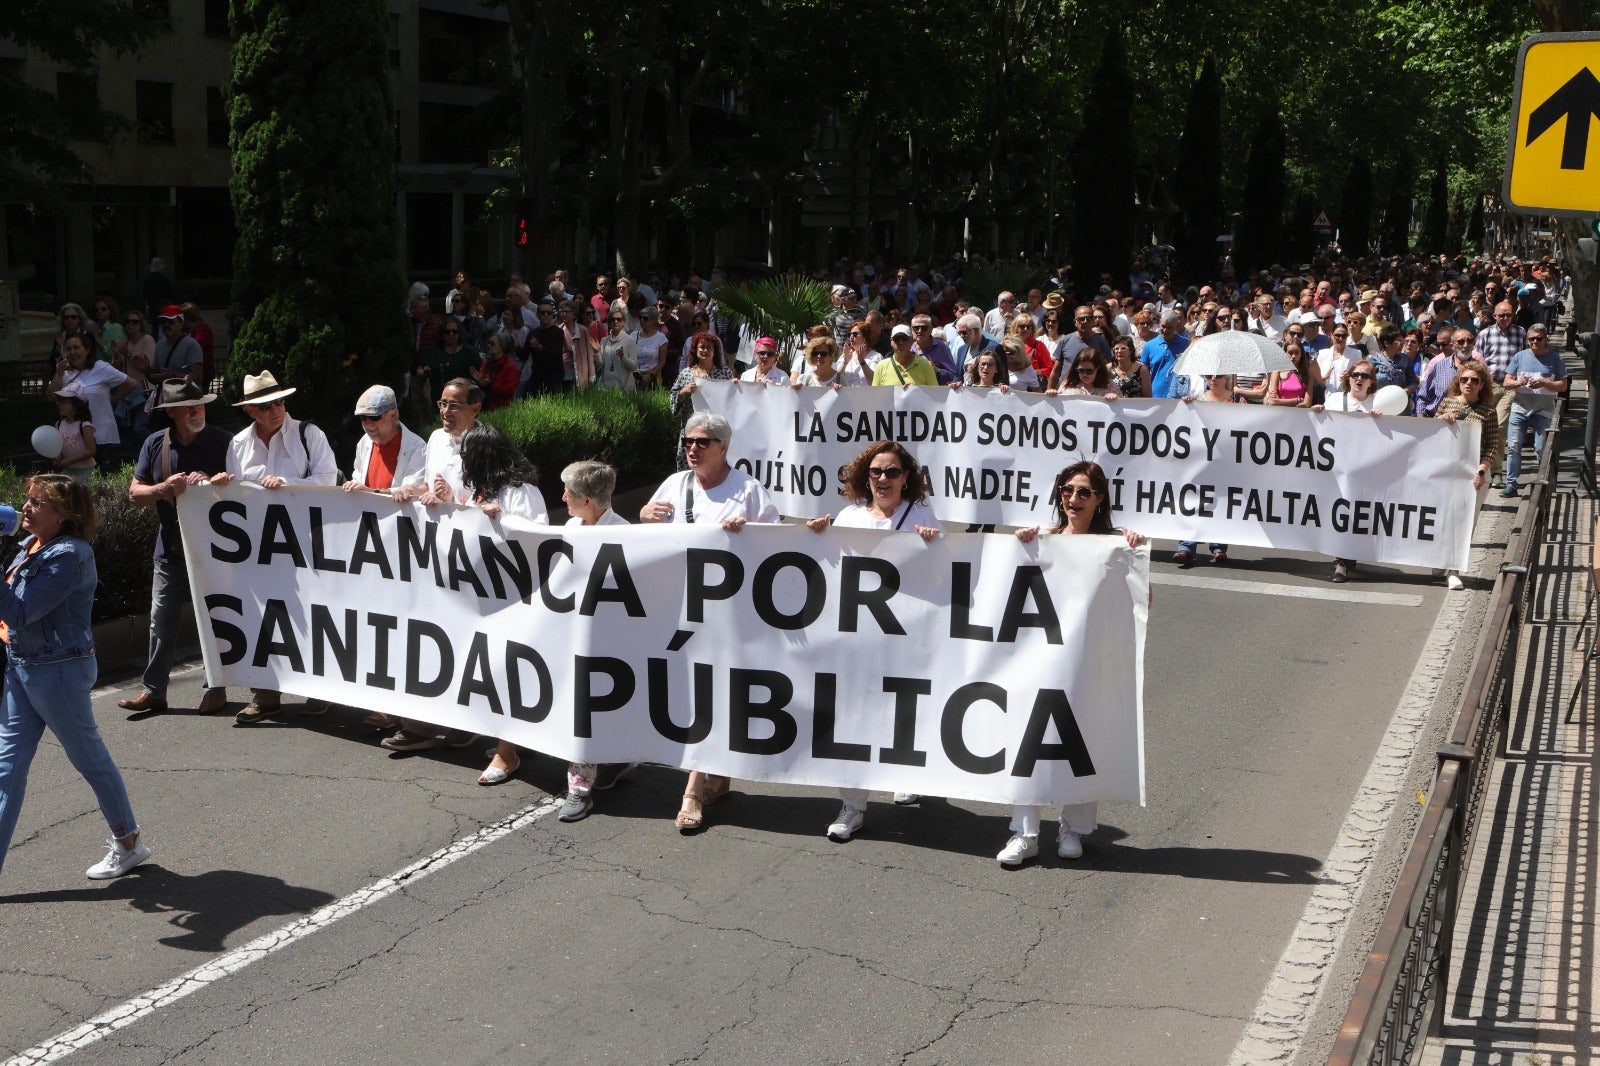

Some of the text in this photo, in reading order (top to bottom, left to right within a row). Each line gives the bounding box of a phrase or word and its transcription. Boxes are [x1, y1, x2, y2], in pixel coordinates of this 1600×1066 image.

[795, 411, 1336, 472] LA SANIDAD SOMOS TODOS Y TODAS
[791, 464, 827, 497] NO
[944, 466, 1039, 511] NADIE,
[1136, 479, 1216, 518] HACE
[1226, 487, 1322, 528] FALTA
[1331, 498, 1437, 541] GENTE
[208, 500, 1064, 645] SALAMANCA POR LA
[204, 593, 1097, 778] SANIDAD PÚBLICA
